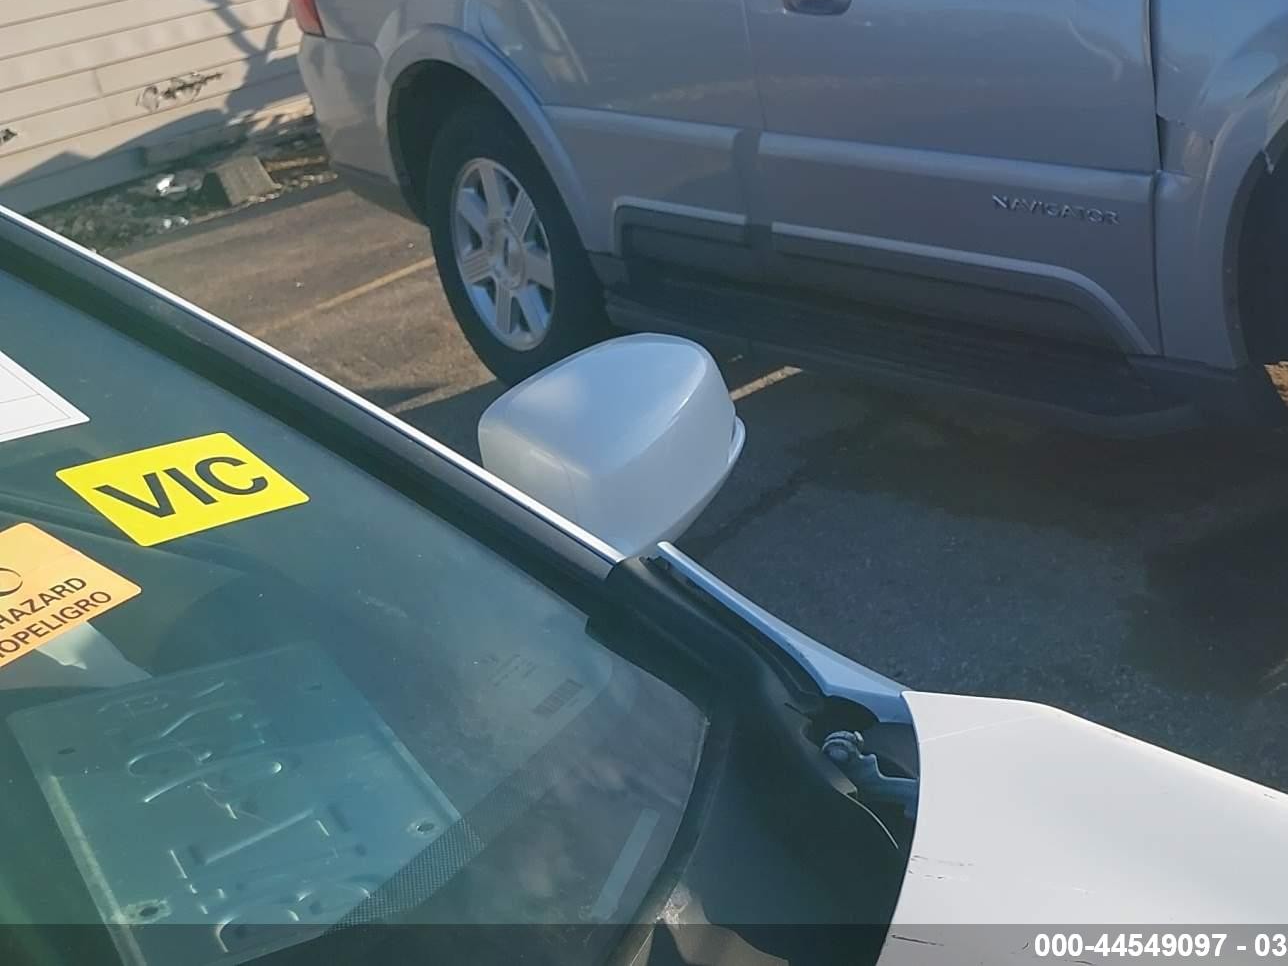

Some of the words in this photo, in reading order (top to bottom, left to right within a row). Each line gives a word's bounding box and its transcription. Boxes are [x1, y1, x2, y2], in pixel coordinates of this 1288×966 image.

[992, 194, 1121, 225] NAVIGATOR
[93, 456, 269, 518] VIC
[0, 591, 112, 658] OPELIGRO
